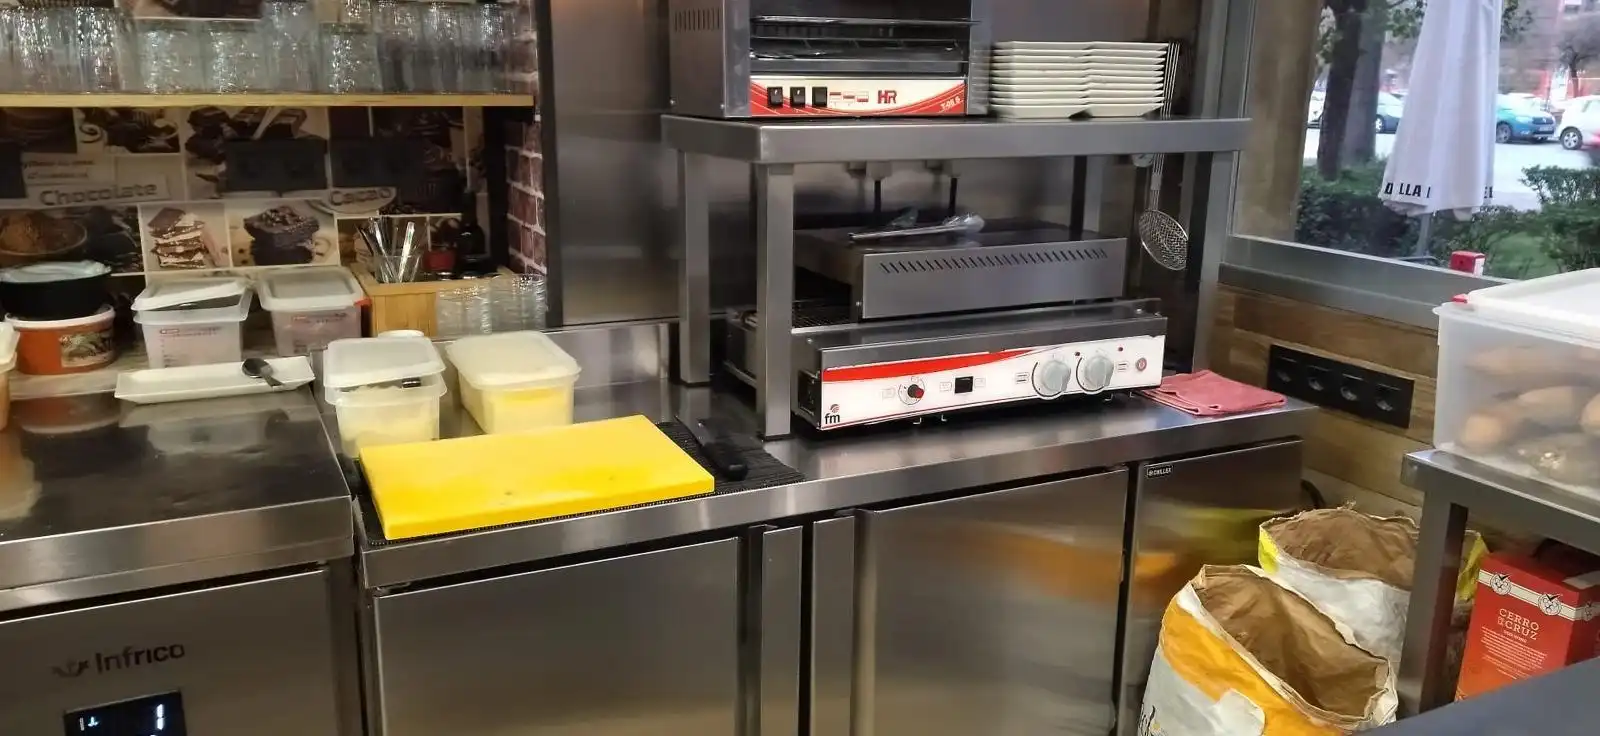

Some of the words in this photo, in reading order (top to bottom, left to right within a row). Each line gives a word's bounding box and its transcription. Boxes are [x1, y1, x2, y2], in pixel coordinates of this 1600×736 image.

[877, 90, 897, 104] HR
[39, 184, 158, 206] Chocolate
[330, 188, 392, 206] Cacao
[824, 412, 841, 424] fm
[1499, 608, 1540, 631] CERRO
[1505, 620, 1538, 641] CRUZ
[95, 644, 186, 675] Infrico
